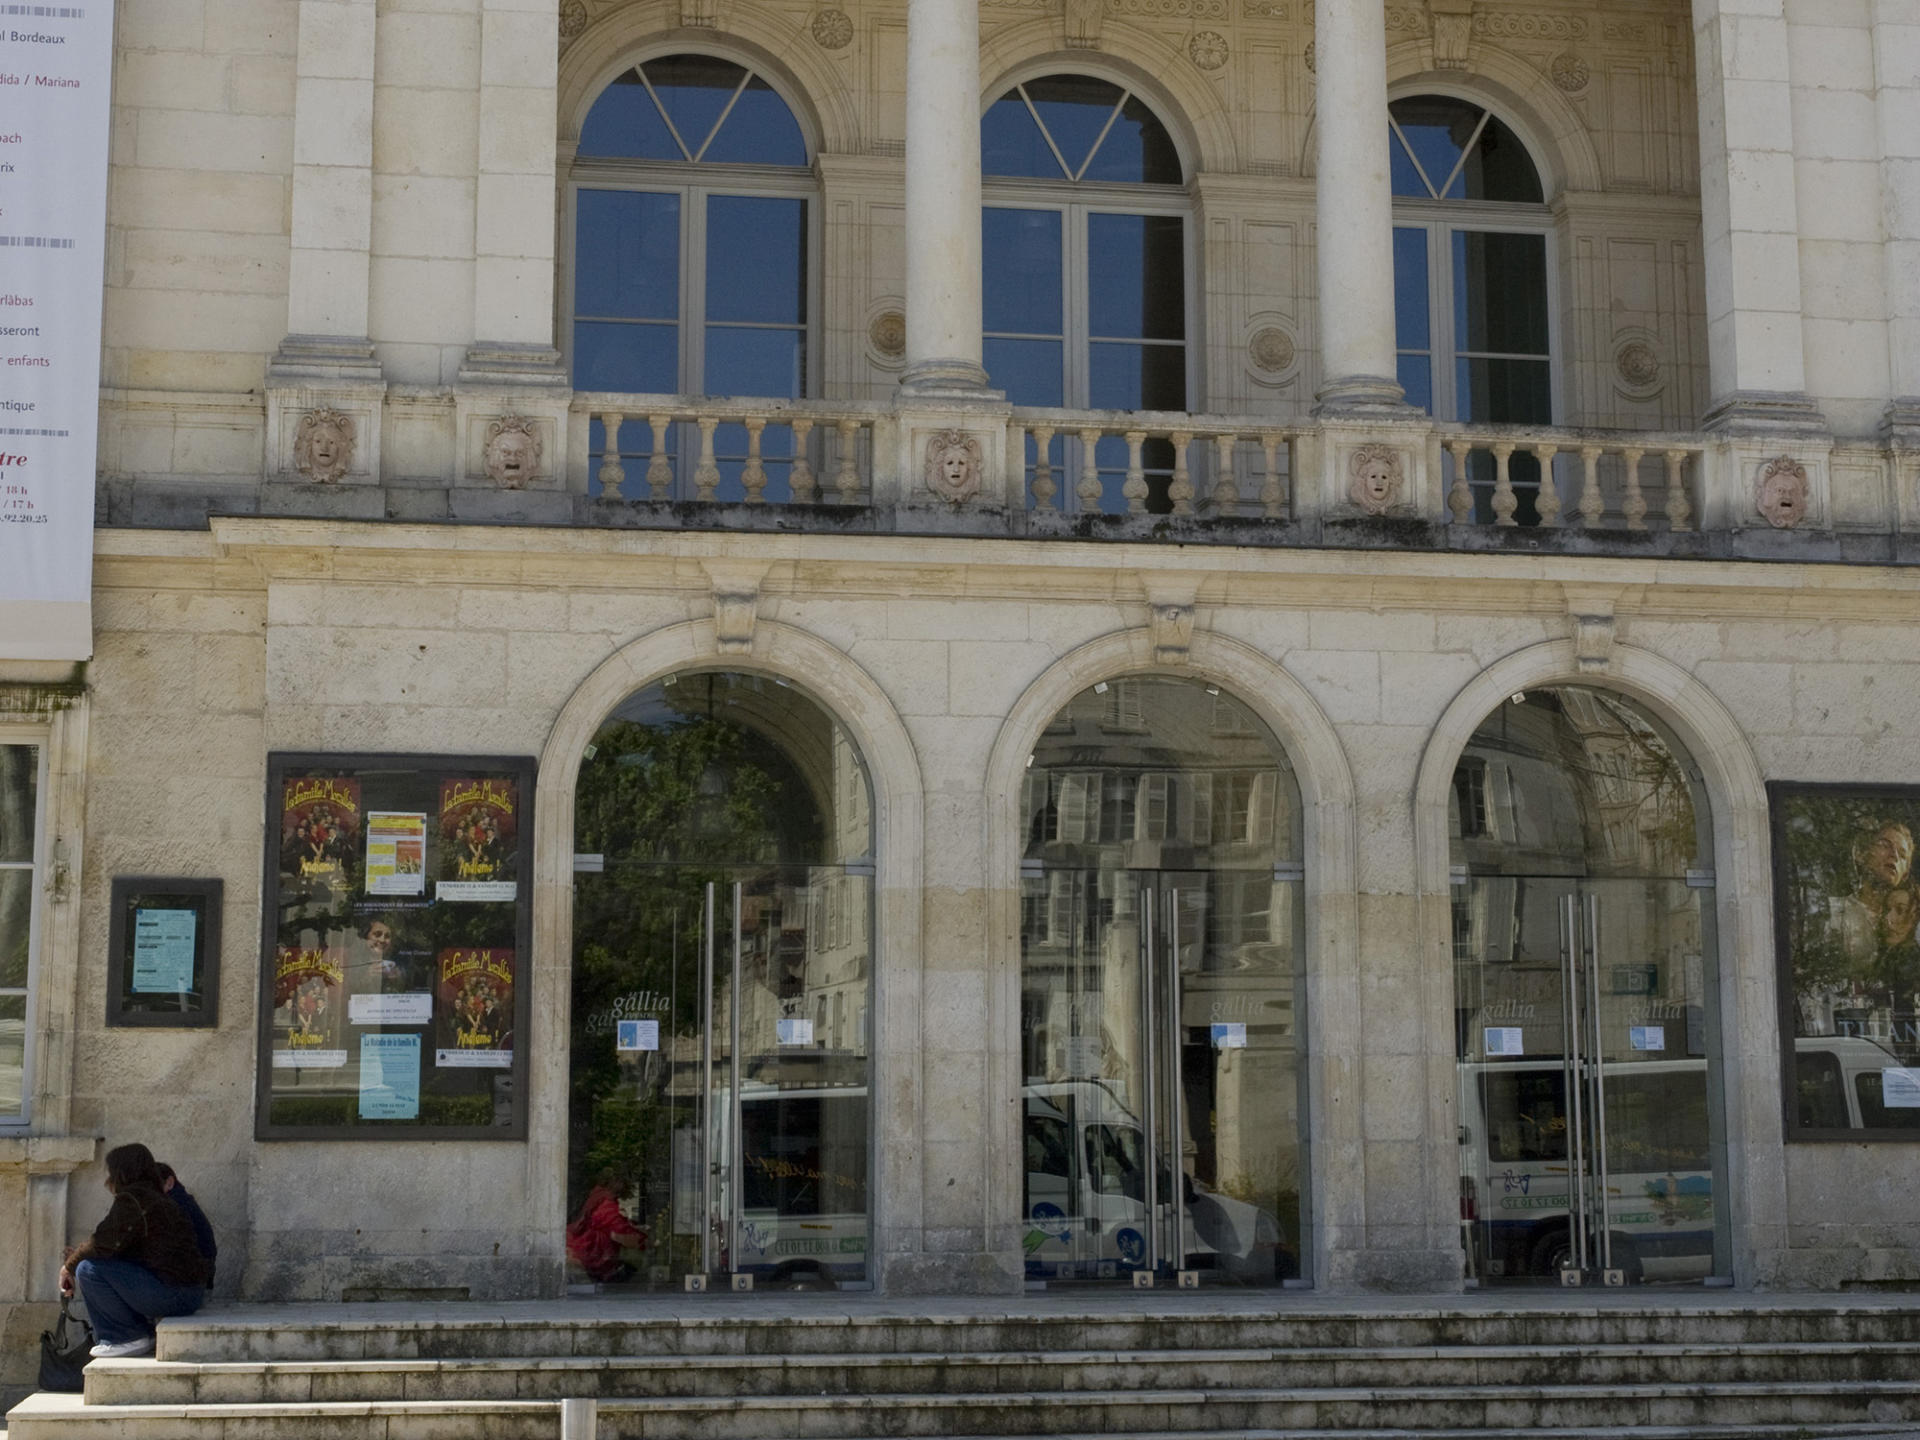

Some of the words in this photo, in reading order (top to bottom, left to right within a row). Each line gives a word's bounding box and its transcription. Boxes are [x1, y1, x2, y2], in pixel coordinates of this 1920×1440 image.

[11, 31, 66, 44] Bordeaux
[35, 75, 80, 88] Mariana
[7, 354, 50, 367] enfants
